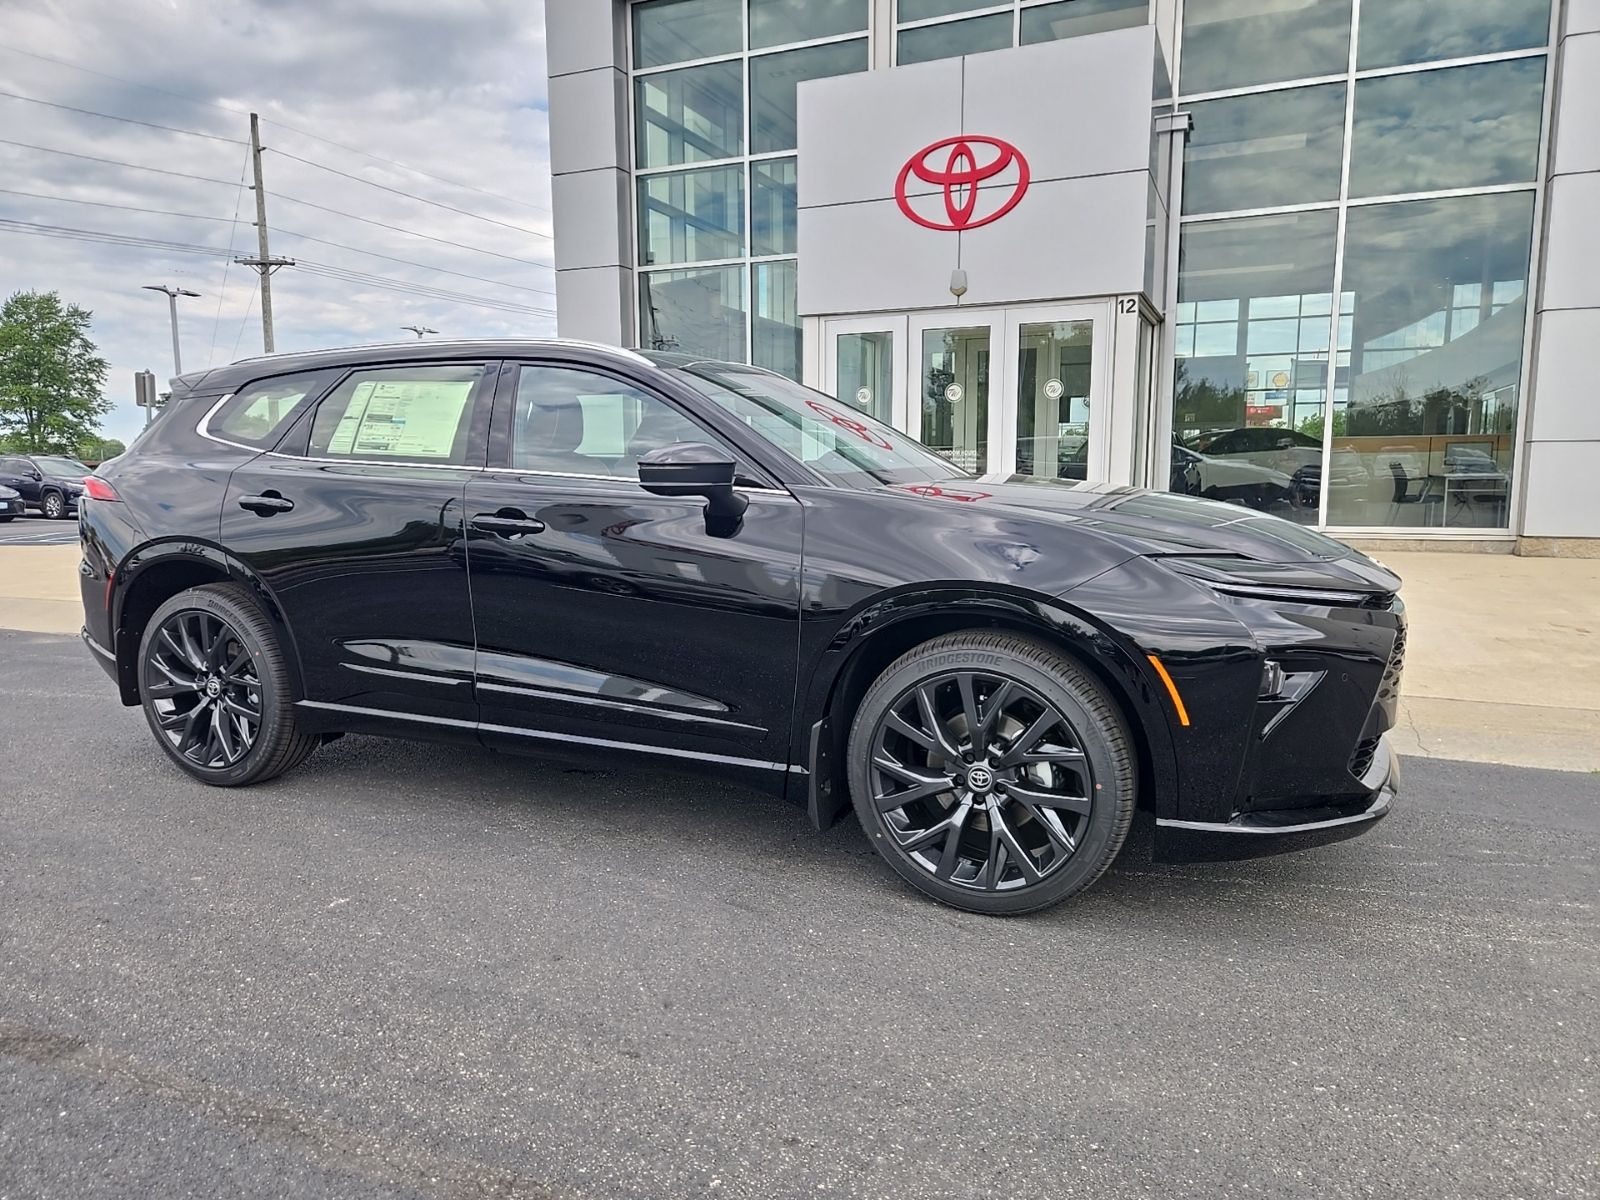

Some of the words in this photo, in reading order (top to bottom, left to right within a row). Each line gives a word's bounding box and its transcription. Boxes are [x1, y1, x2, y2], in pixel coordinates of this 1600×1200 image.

[1118, 298, 1137, 314] 12
[207, 599, 252, 637] BRIDGESTONE
[916, 651, 1004, 672] BRIDGESTONE
